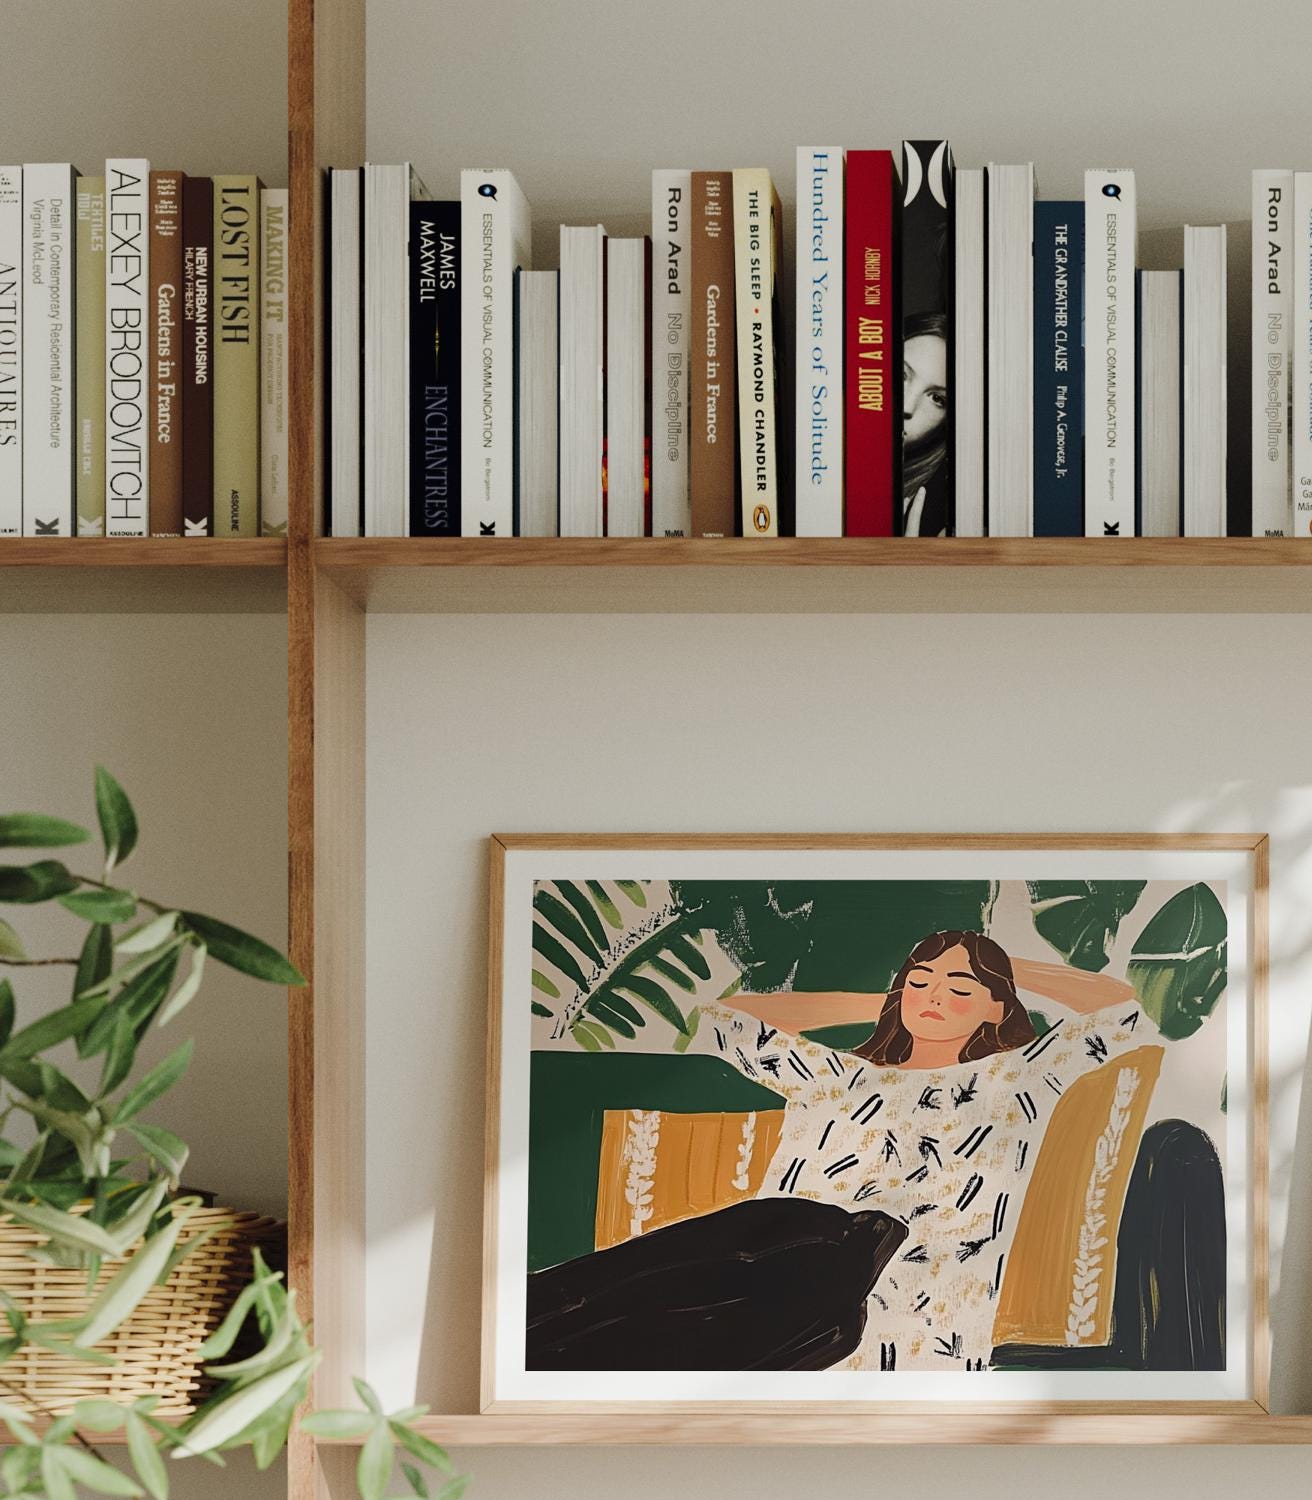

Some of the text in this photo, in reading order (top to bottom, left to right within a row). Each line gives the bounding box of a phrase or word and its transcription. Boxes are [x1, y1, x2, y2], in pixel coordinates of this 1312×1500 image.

[29, 199, 44, 285] Virginia McLeod
[49, 199, 62, 233] Detail
[266, 205, 284, 295] MAKING
[482, 213, 493, 283] ESSENTIALS
[1106, 213, 1116, 283] ESSENTIALS
[46, 244, 62, 320] Contemporary
[184, 247, 194, 320] HILARY FRENCH
[221, 186, 250, 345] LOST FISH
[419, 220, 436, 303] MAXWELL
[439, 233, 455, 290] JAMES
[482, 285, 493, 302] OF
[864, 247, 881, 305] NICK HORNBY
[1054, 224, 1068, 372] THE GRANDFATHER CLAUSE
[1106, 285, 1116, 303] OF
[49, 323, 62, 383] Residential
[110, 169, 142, 519] ALEXEY BRODOVITCH
[195, 246, 207, 384] NEW URBAN HOUSING
[266, 300, 284, 323] IT
[482, 304, 493, 345] VISUAL
[664, 187, 683, 461] Ron Arad No Discipline
[748, 190, 767, 492] THE BIG SLEEP RAYMOND CHANDLER
[810, 153, 829, 486] Hundred Years of Solitude
[1106, 304, 1116, 345] VISUAL
[1265, 187, 1283, 462] Ron Arad No Discipline
[157, 283, 176, 443] Gardens in France
[482, 347, 493, 448] COMMUNICATION
[706, 284, 720, 443] Gardens in France
[858, 317, 884, 411] ABOUT A BOY
[1106, 348, 1116, 449] COMMUNICATION
[49, 385, 62, 448] Architecture
[424, 385, 448, 528] ENCHANTRESS
[231, 489, 239, 532] ASSOULINE
